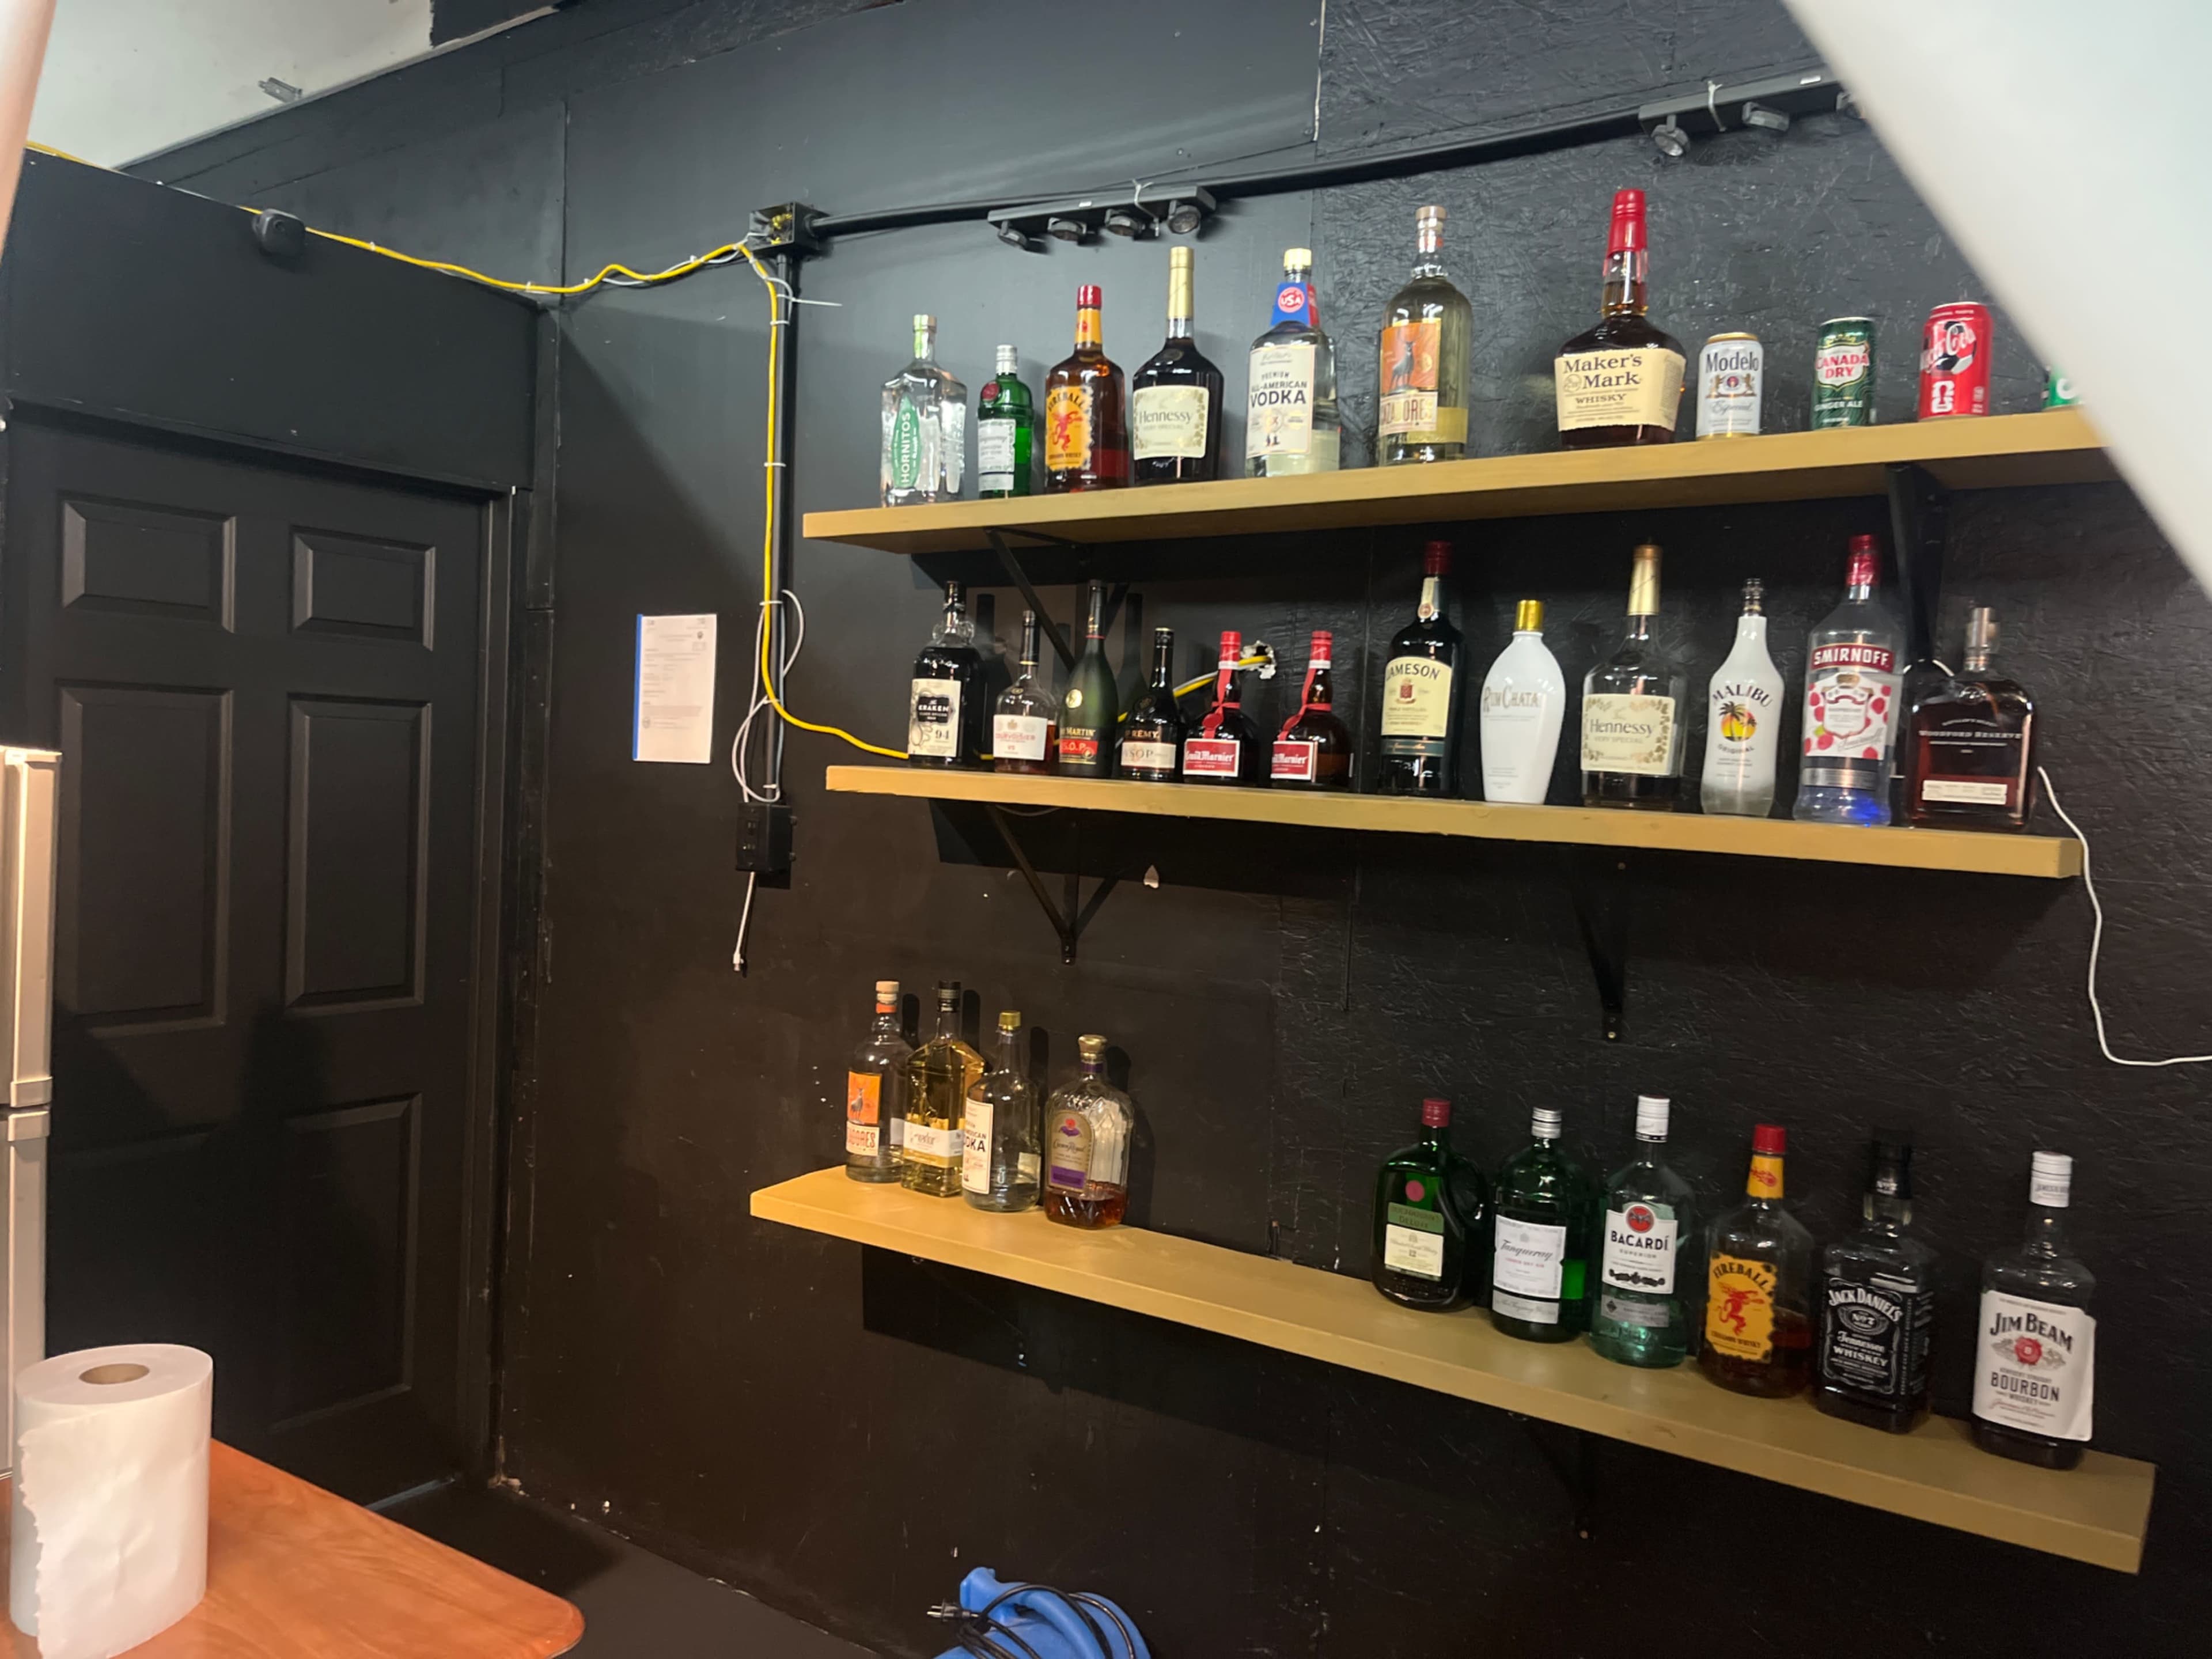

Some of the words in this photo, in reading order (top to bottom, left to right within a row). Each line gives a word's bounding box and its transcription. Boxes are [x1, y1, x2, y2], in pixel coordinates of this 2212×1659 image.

[1281, 294, 1302, 306] USA
[1563, 354, 1643, 374] Maker's
[1706, 351, 1759, 373] Modelo
[1816, 353, 1869, 370] CANADA
[1583, 372, 1641, 389] Mark
[1825, 366, 1855, 378] DRY
[1251, 380, 1307, 393] ALL-AMERICAN
[1048, 392, 1084, 412] FIREBALL
[1250, 389, 1306, 408] VODKA
[1575, 393, 1627, 404] WHISKY
[1846, 400, 1863, 408] ALE
[1139, 410, 1192, 426] Hennessy
[900, 411, 911, 483] HORNITOS
[1814, 647, 1889, 666] SMIRNOFF
[1386, 662, 1440, 681] JAMESON
[1712, 684, 1773, 708] MALIBU
[934, 729, 950, 740] 94
[1066, 727, 1096, 737] MARTIN
[1589, 718, 1654, 738] Hennessy
[1611, 1230, 1669, 1251] BACARDÍ
[1500, 1239, 1554, 1262] Tanqueray
[1619, 1248, 1657, 1259] SUPERIOR
[1713, 1262, 1768, 1291] FIREBALL
[1828, 1290, 1857, 1306] JACK
[1857, 1288, 1903, 1323] DANIEL'S
[1990, 1312, 2022, 1336] JIM
[2025, 1312, 2074, 1354] BEAM
[1833, 1345, 1889, 1368] WHISKEY
[1990, 1372, 2061, 1402] BOURBON
